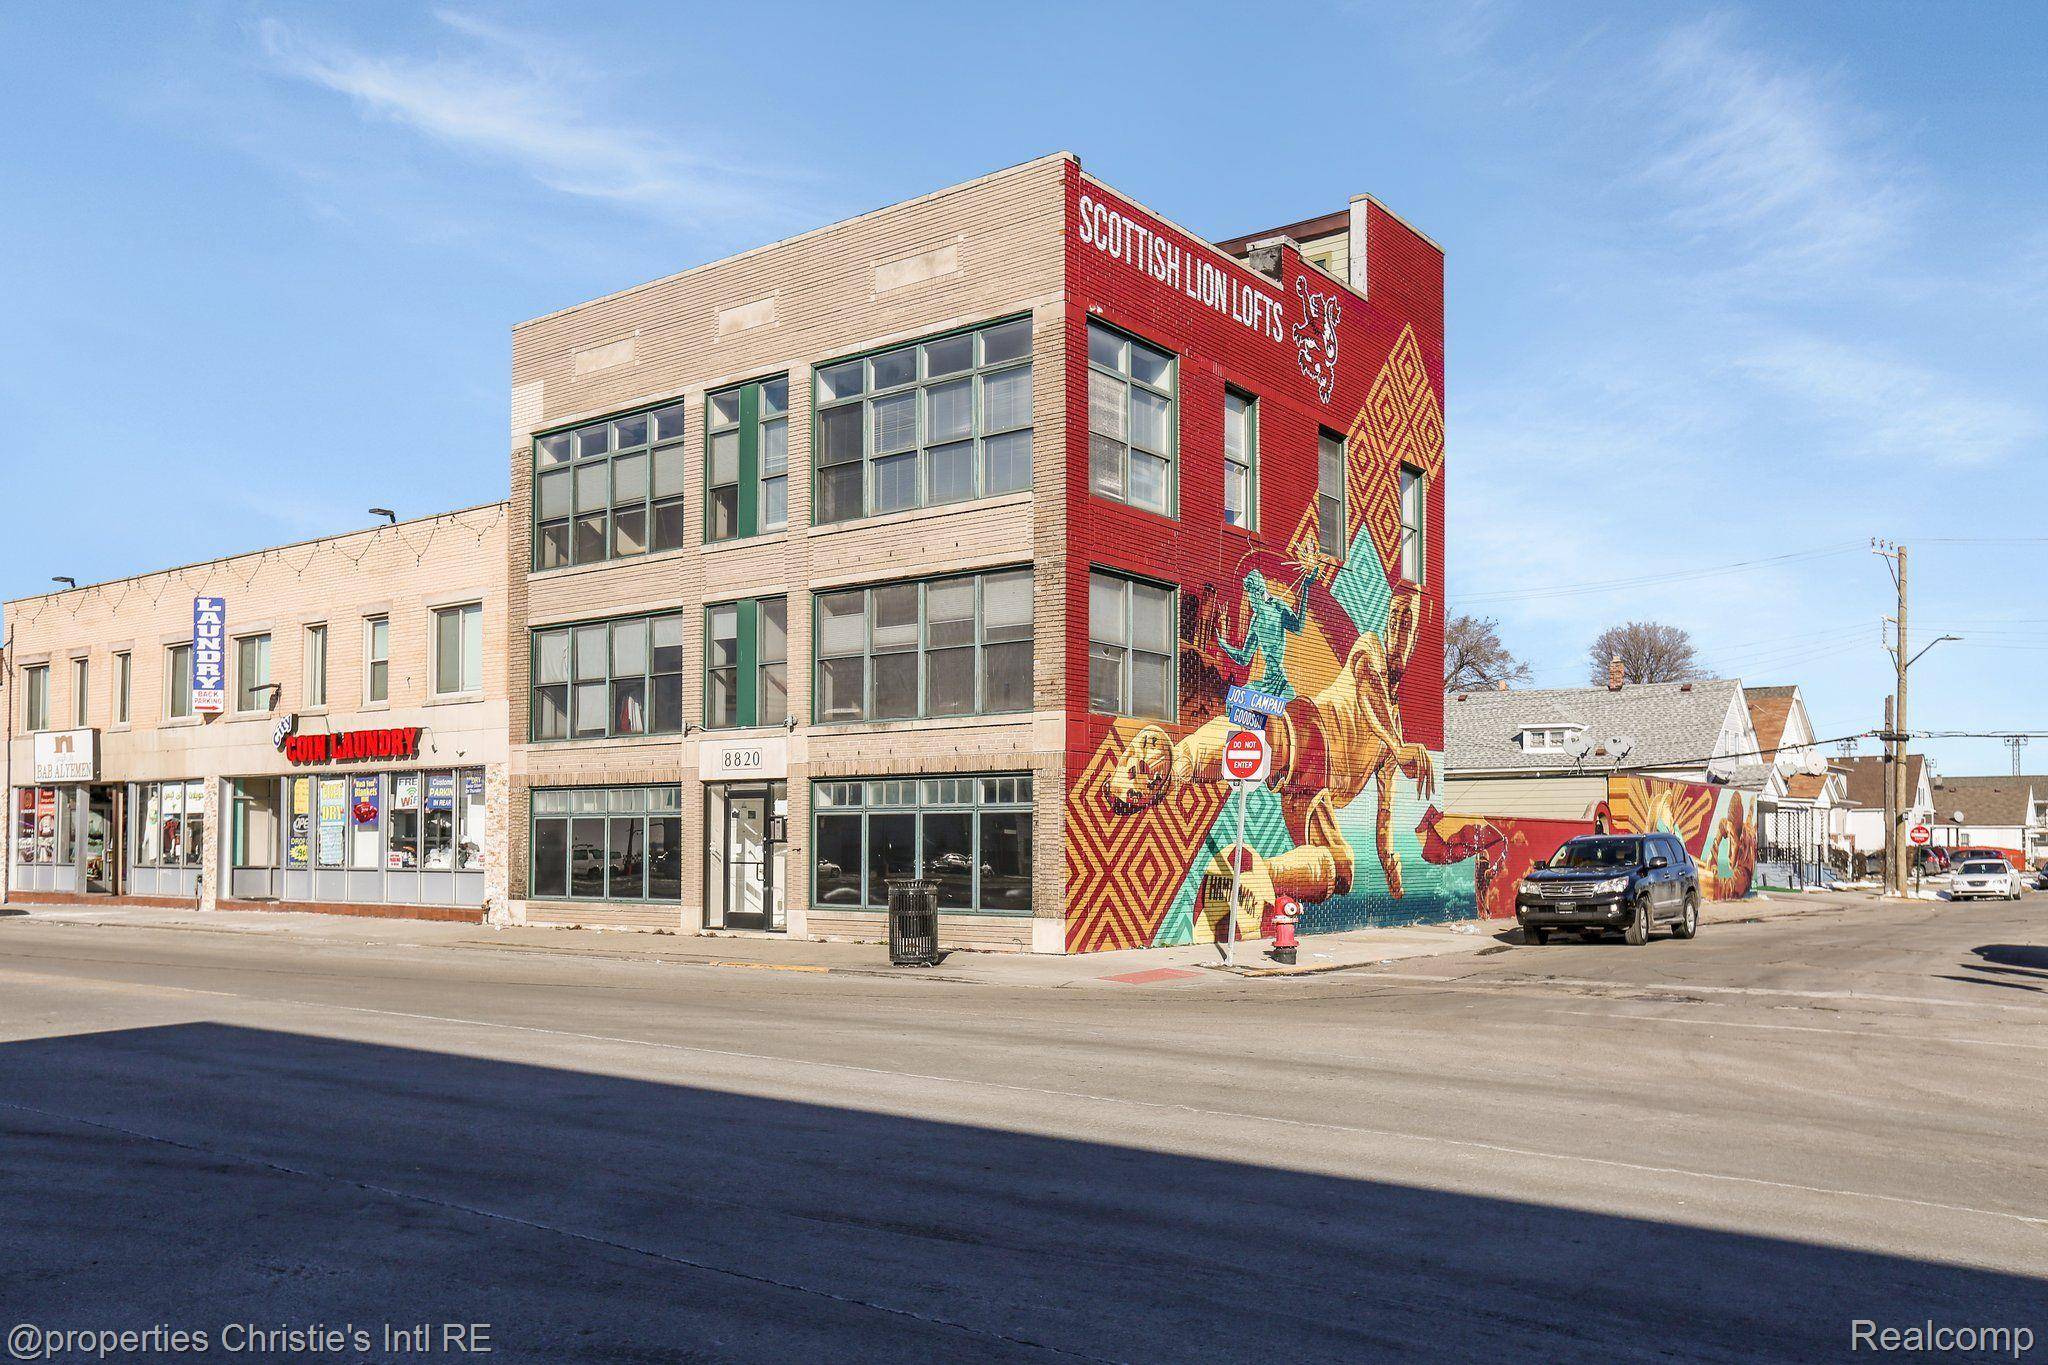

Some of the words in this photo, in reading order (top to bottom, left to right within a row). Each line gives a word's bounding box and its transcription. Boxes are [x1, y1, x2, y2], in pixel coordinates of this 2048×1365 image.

[1078, 195, 1180, 291] SCOTTISH
[1186, 251, 1228, 315] LION
[1232, 278, 1284, 343] LOFTS
[197, 599, 222, 689] LAUNDRY
[1250, 693, 1284, 714] CAMPAU
[1233, 708, 1264, 728] GOODSON
[273, 717, 291, 747] City
[286, 734, 327, 762] COIN
[330, 727, 417, 759] LAUNDRY
[724, 751, 760, 767] 8820
[1233, 761, 1253, 769] ENTER
[37, 764, 52, 778] BAB
[398, 777, 418, 786] FRE
[429, 788, 453, 797] PARKIN
[296, 817, 309, 830] OPE
